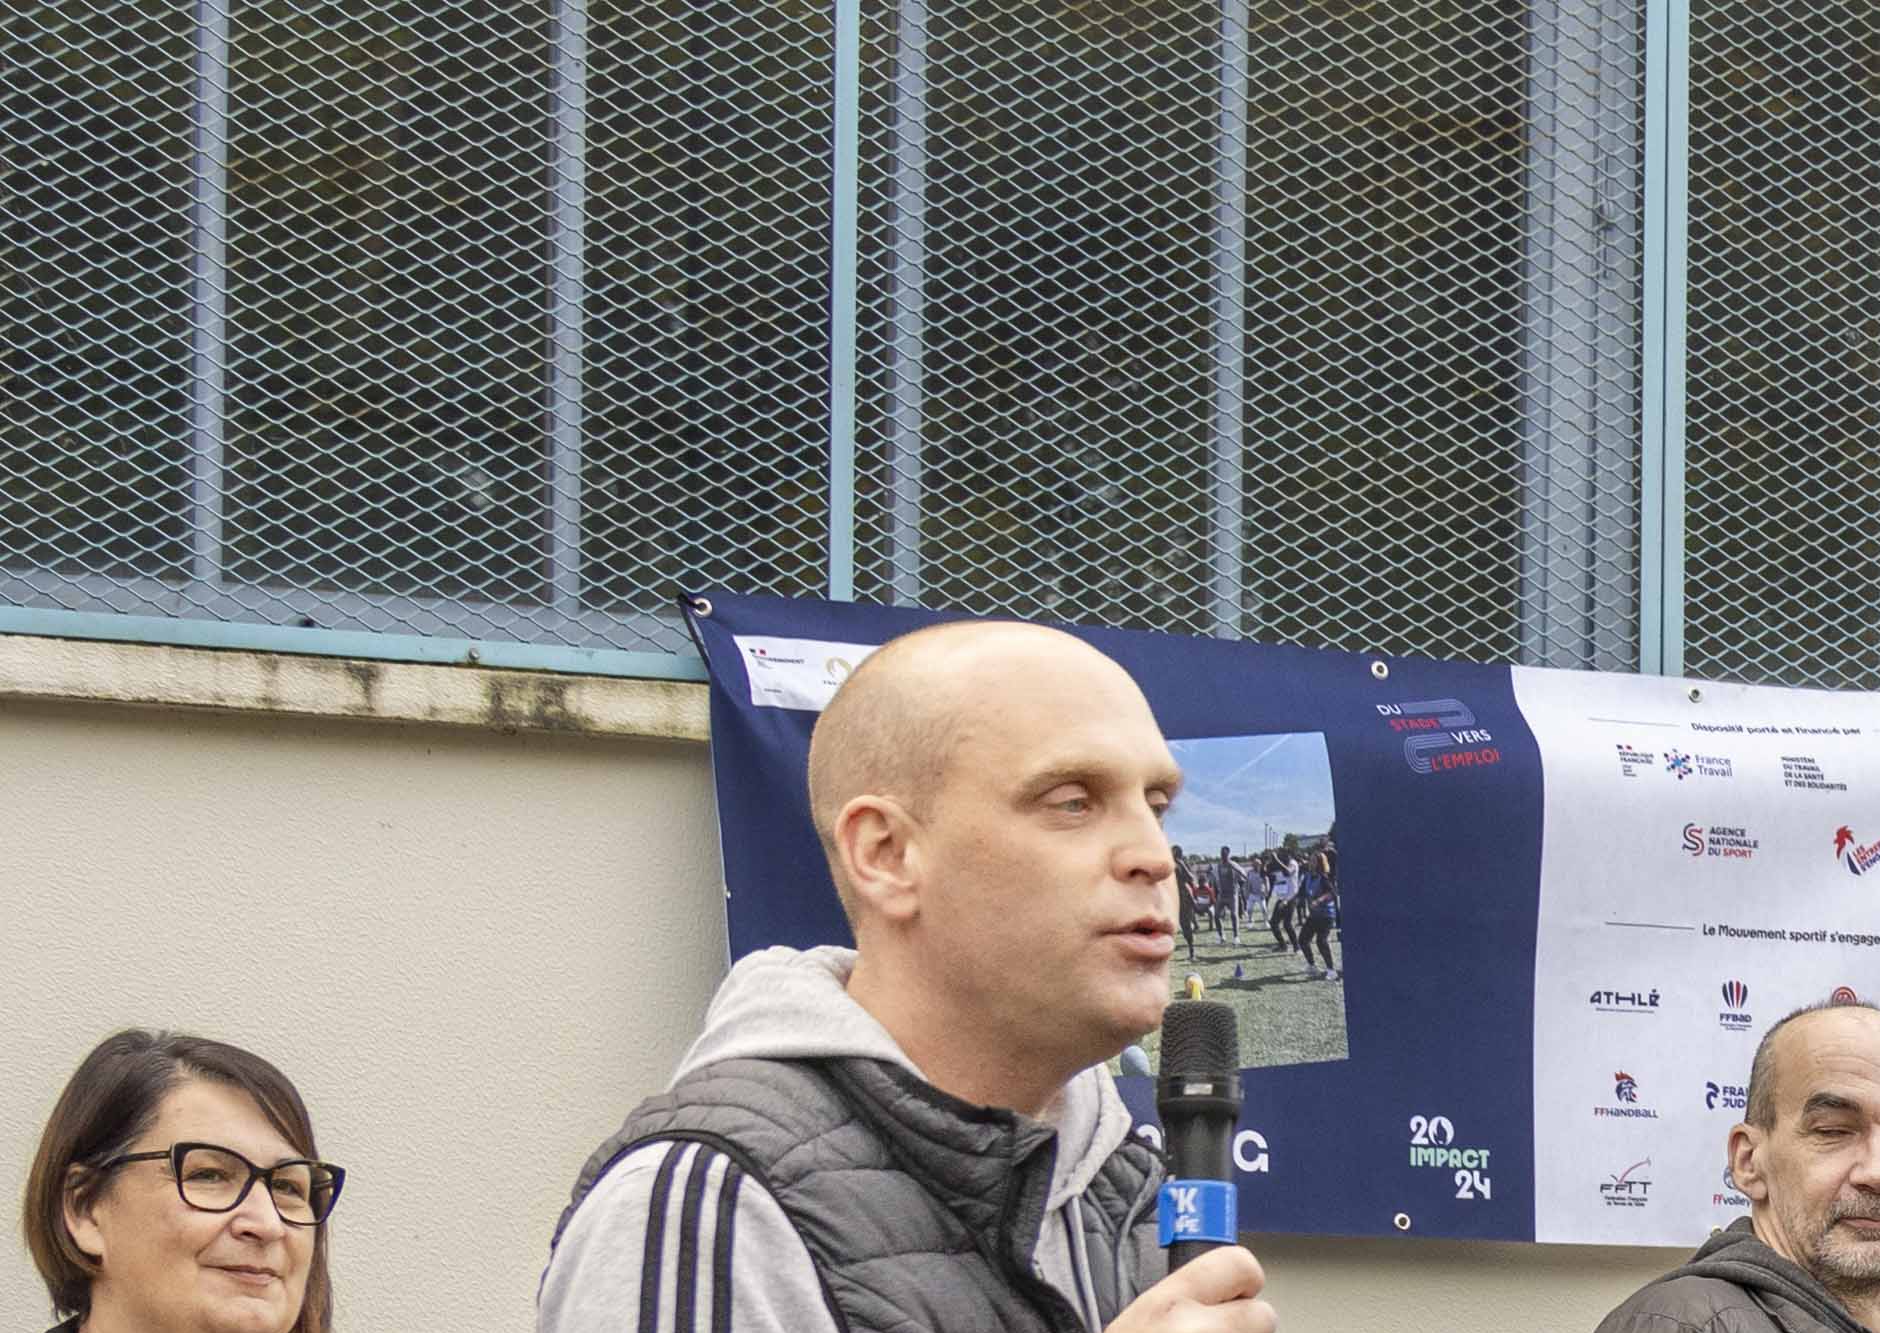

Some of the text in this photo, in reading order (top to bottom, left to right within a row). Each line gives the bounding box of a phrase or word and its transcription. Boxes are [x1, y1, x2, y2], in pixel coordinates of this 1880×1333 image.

[1376, 703, 1402, 715] DU
[1450, 729, 1492, 744] VERS
[1431, 748, 1500, 772] L'EMPLOI
[1695, 754, 1731, 766] France
[1697, 765, 1733, 777] Travail
[1709, 826, 1746, 838] AGENCE
[1709, 836, 1759, 849] NATIONALE
[1708, 847, 1753, 859] DU SPORT
[1703, 923, 1880, 947] Le Mouvement sportif s'engage
[1590, 988, 1660, 1008] ATHLÉ
[1409, 1115, 1455, 1146] 20
[1409, 1147, 1490, 1169] IMPACT
[1455, 1170, 1491, 1199] 24
